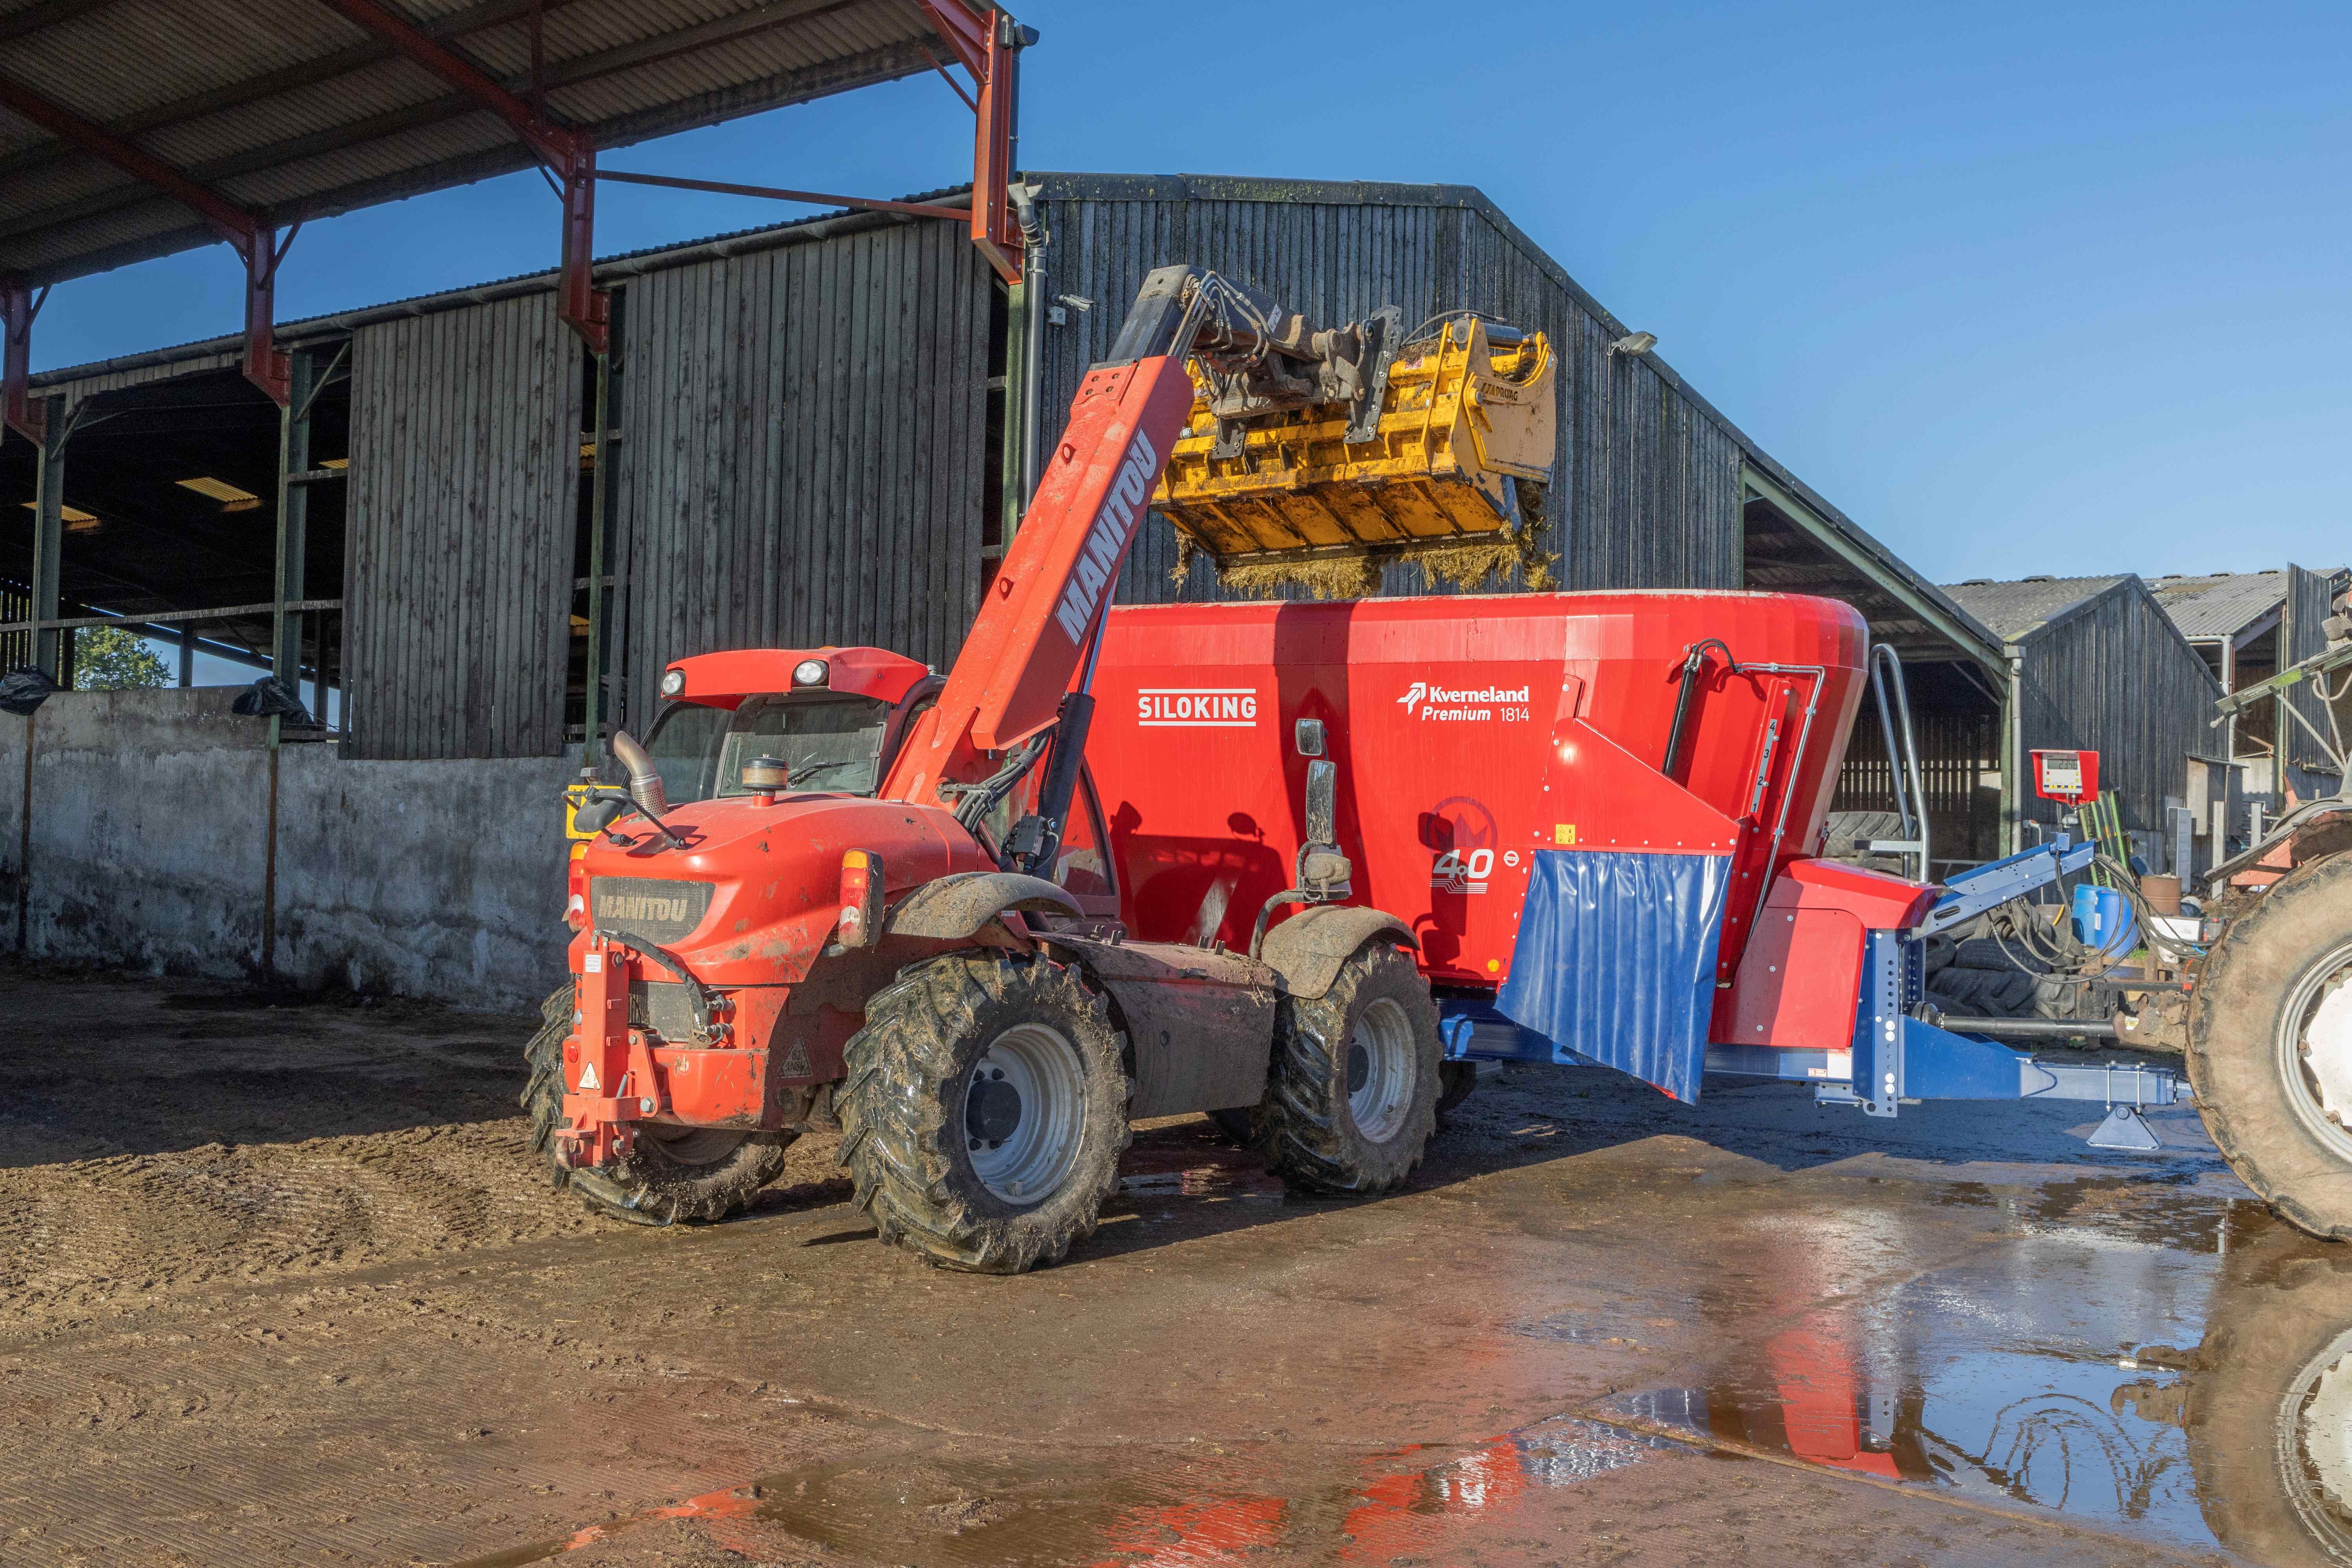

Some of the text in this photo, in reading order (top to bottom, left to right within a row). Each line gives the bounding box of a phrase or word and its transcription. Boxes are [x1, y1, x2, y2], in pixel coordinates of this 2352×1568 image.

[1055, 428, 1156, 648] MANITOU
[1430, 686, 1529, 702] Kverneland
[1138, 697, 1256, 718] SILOKING
[1422, 706, 1529, 722] Premium 1814
[1769, 722, 1775, 731] 4
[1764, 749, 1769, 758] 3
[1758, 776, 1764, 786] 2
[1753, 804, 1757, 813] 1
[598, 895, 688, 922] MANITOU
